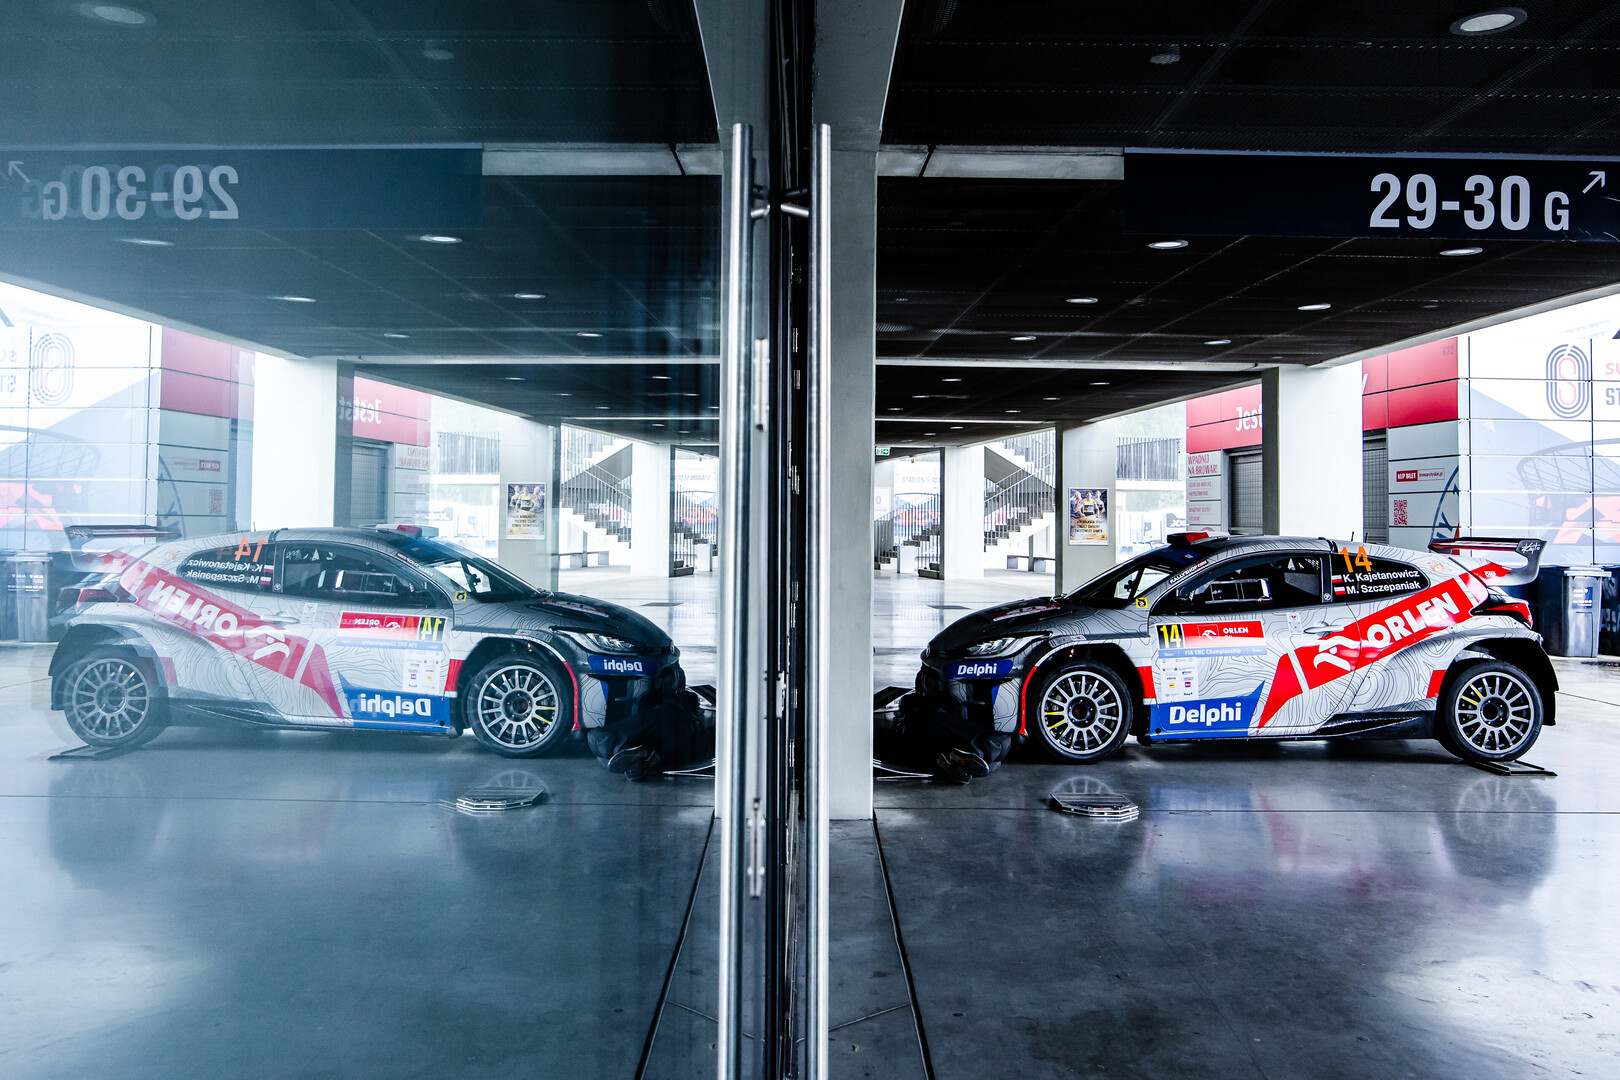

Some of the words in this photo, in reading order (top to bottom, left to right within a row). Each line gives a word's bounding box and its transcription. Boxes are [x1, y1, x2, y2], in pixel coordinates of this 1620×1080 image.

[1369, 173, 1530, 230] 29-30
[1544, 191, 1570, 231] G
[1338, 546, 1372, 572] 14
[1343, 574, 1354, 583] K.
[1355, 570, 1420, 583] Kajetanowicz
[1347, 586, 1360, 595] M.
[1361, 581, 1421, 594] Szczepaniak
[1367, 592, 1460, 649] ORLEN
[1160, 624, 1181, 649] 14
[957, 663, 998, 677] Delphi
[1169, 702, 1241, 726] Delphi
